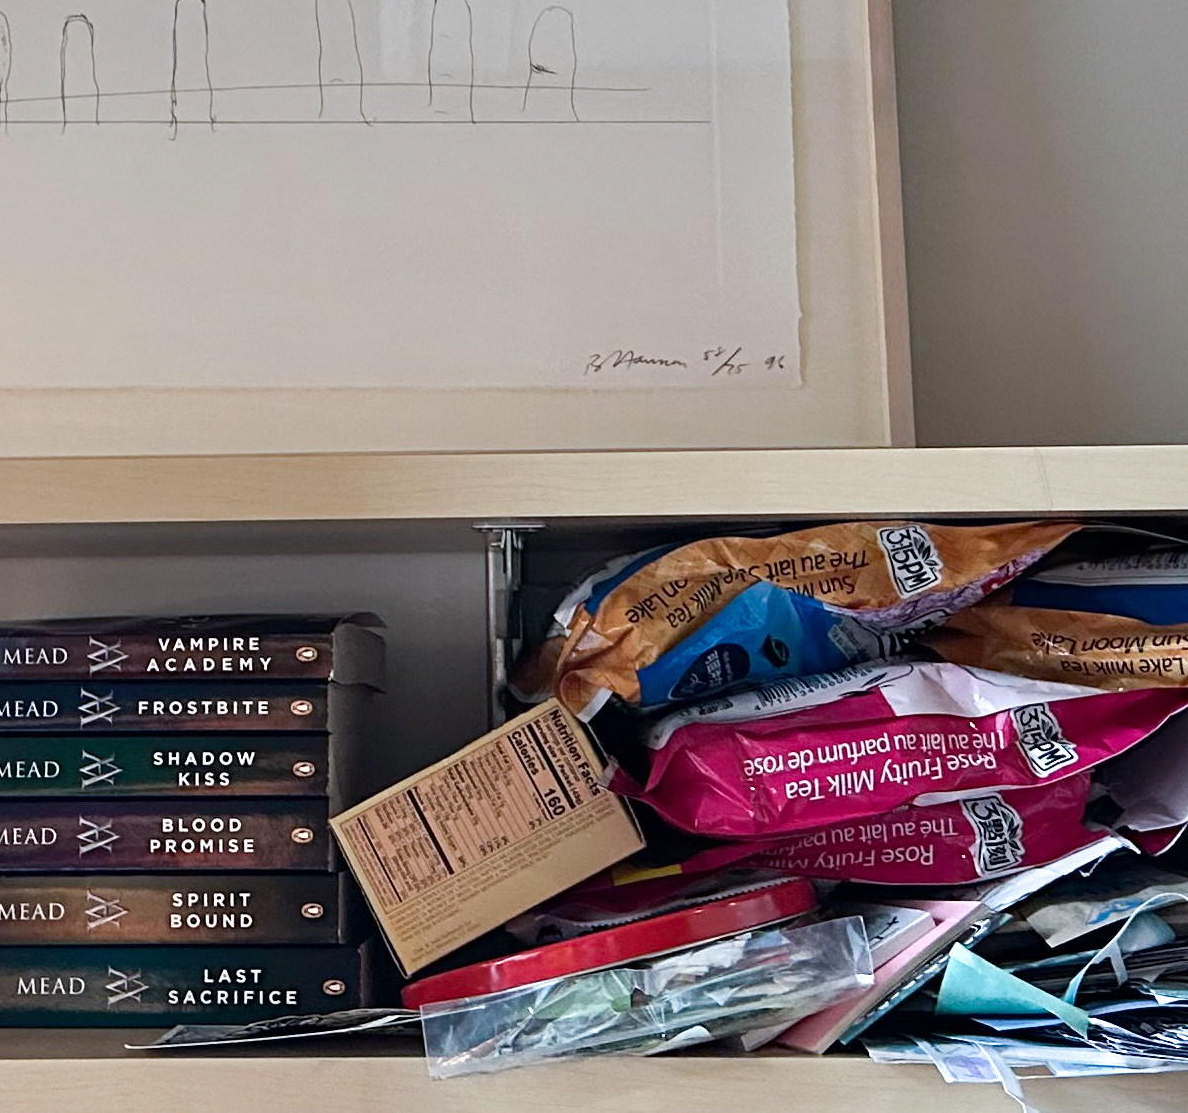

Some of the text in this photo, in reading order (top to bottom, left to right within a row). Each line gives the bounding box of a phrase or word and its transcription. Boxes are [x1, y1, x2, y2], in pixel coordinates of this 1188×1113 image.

[764, 558, 797, 582] lait
[800, 554, 825, 572] au
[819, 575, 855, 595] Sun
[625, 593, 669, 623] Lake
[666, 577, 722, 628] Milk Tea
[158, 637, 260, 652] VAMPIRE
[1031, 632, 1077, 655] Lake
[1081, 636, 1146, 654] Moon
[3, 648, 68, 665] MEAD
[146, 657, 272, 672] ACADEMY
[1060, 657, 1185, 676] Lake Milk Tea
[138, 700, 269, 715] FROSTBITE
[817, 734, 889, 764] parfum
[893, 733, 917, 752] au
[920, 732, 946, 753] lait
[944, 733, 970, 750] au
[153, 751, 256, 766] SHADOW
[549, 708, 602, 797] Nutrition Facts
[788, 750, 812, 772] de
[178, 772, 230, 787] KISS
[510, 729, 567, 818] Calories 160
[826, 768, 875, 792] Milk
[881, 757, 944, 785] Fruity
[785, 781, 823, 801] Tea
[162, 817, 242, 833] BLOOD
[859, 823, 888, 845] lait
[892, 822, 916, 837] au
[919, 818, 959, 839] Thé
[831, 827, 855, 844] au
[150, 838, 255, 854] PROMISE
[881, 844, 934, 866] Rose
[814, 848, 876, 871] Fruity
[172, 892, 251, 907] SPIRIT
[170, 913, 253, 929] BOUND
[16, 976, 86, 995] MEAD
[203, 969, 262, 984] LAST
[168, 990, 298, 1005] SACRIFICE
